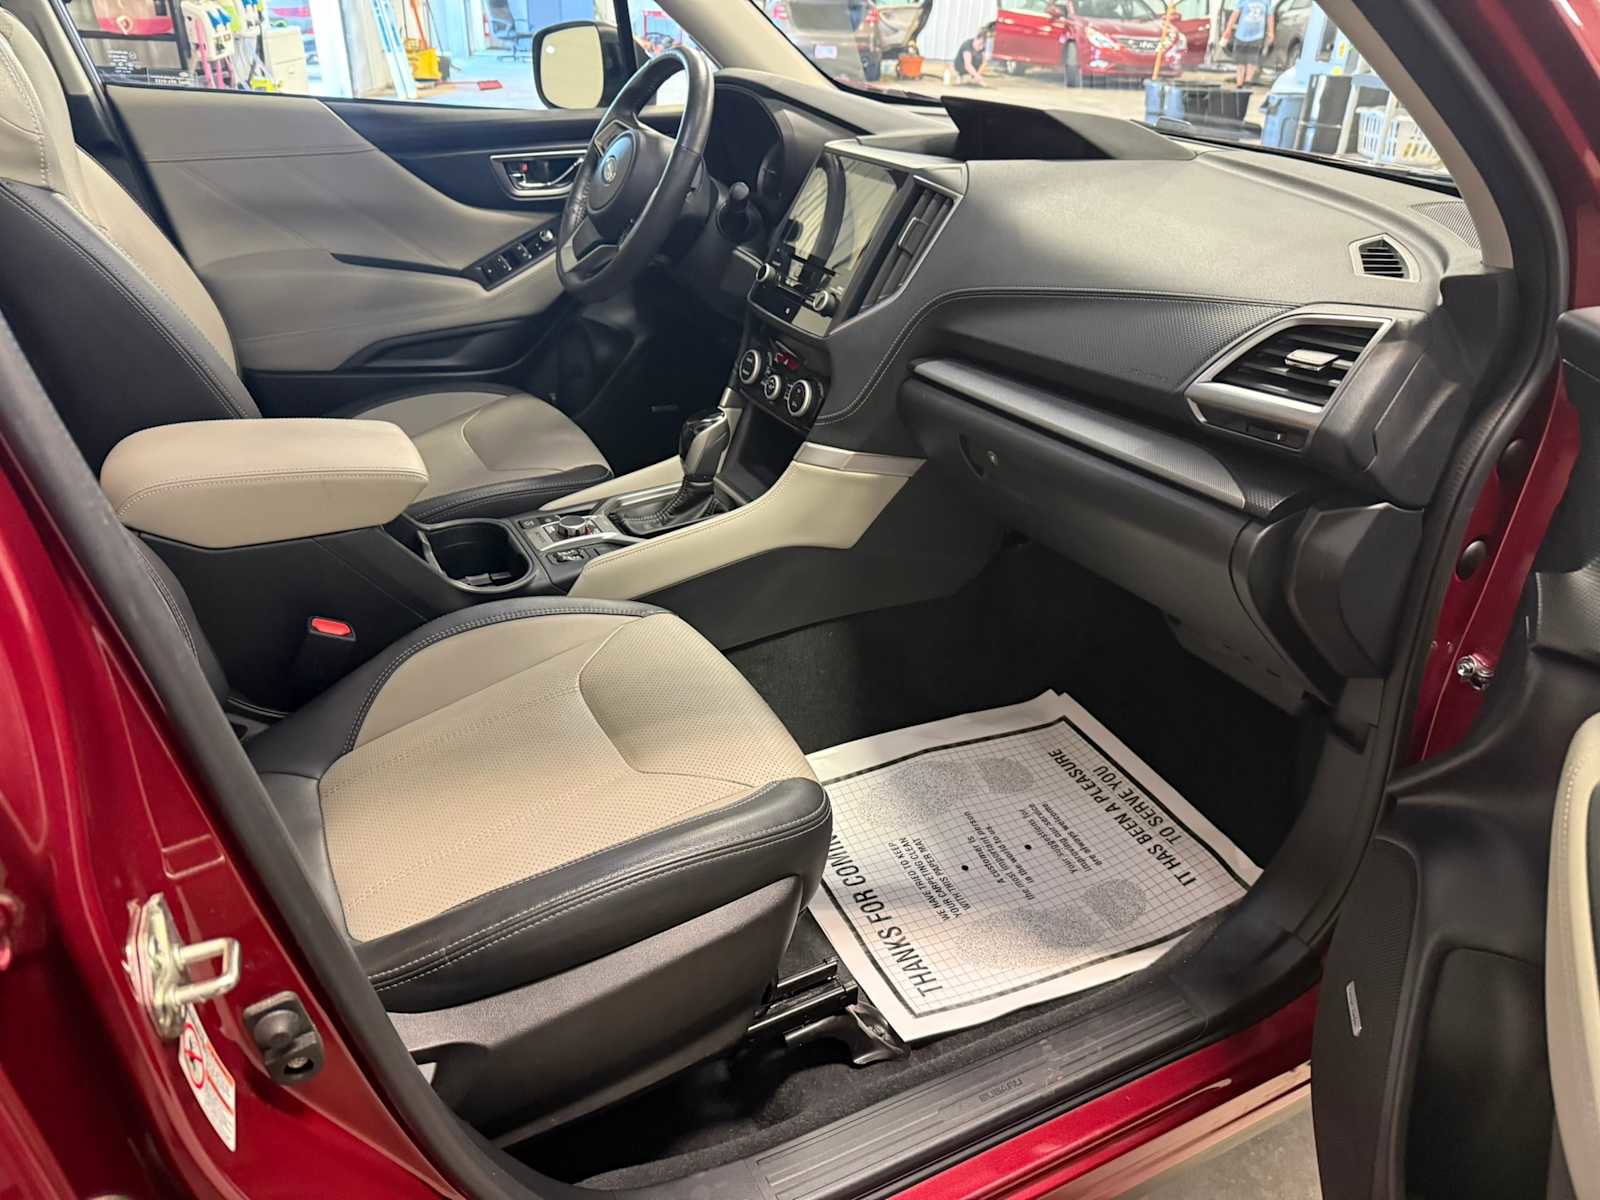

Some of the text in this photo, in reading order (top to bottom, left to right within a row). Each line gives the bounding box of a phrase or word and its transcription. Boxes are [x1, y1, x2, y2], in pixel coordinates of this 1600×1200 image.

[1029, 804, 1093, 872] improving our service
[1048, 748, 1197, 887] IT HAS BEEN A PLEASURE
[1092, 766, 1182, 845] TO SERVE YOU
[964, 811, 1035, 900] the most important person
[968, 835, 976, 843] is
[973, 844, 1000, 878] customer
[993, 835, 1001, 844] to
[998, 844, 1017, 863] world
[1015, 864, 1028, 876] the
[1019, 809, 1078, 874] Your suggestions for
[1067, 831, 1091, 853] always
[1089, 854, 1102, 865] are
[852, 889, 892, 924] FOR
[888, 842, 950, 921] WE HAVE TRIED TO KEEP
[899, 837, 961, 918] YOUR CARPETING CLEAN
[912, 838, 971, 910] WITH THIS PAPER MAT
[878, 926, 943, 997] THANKS
